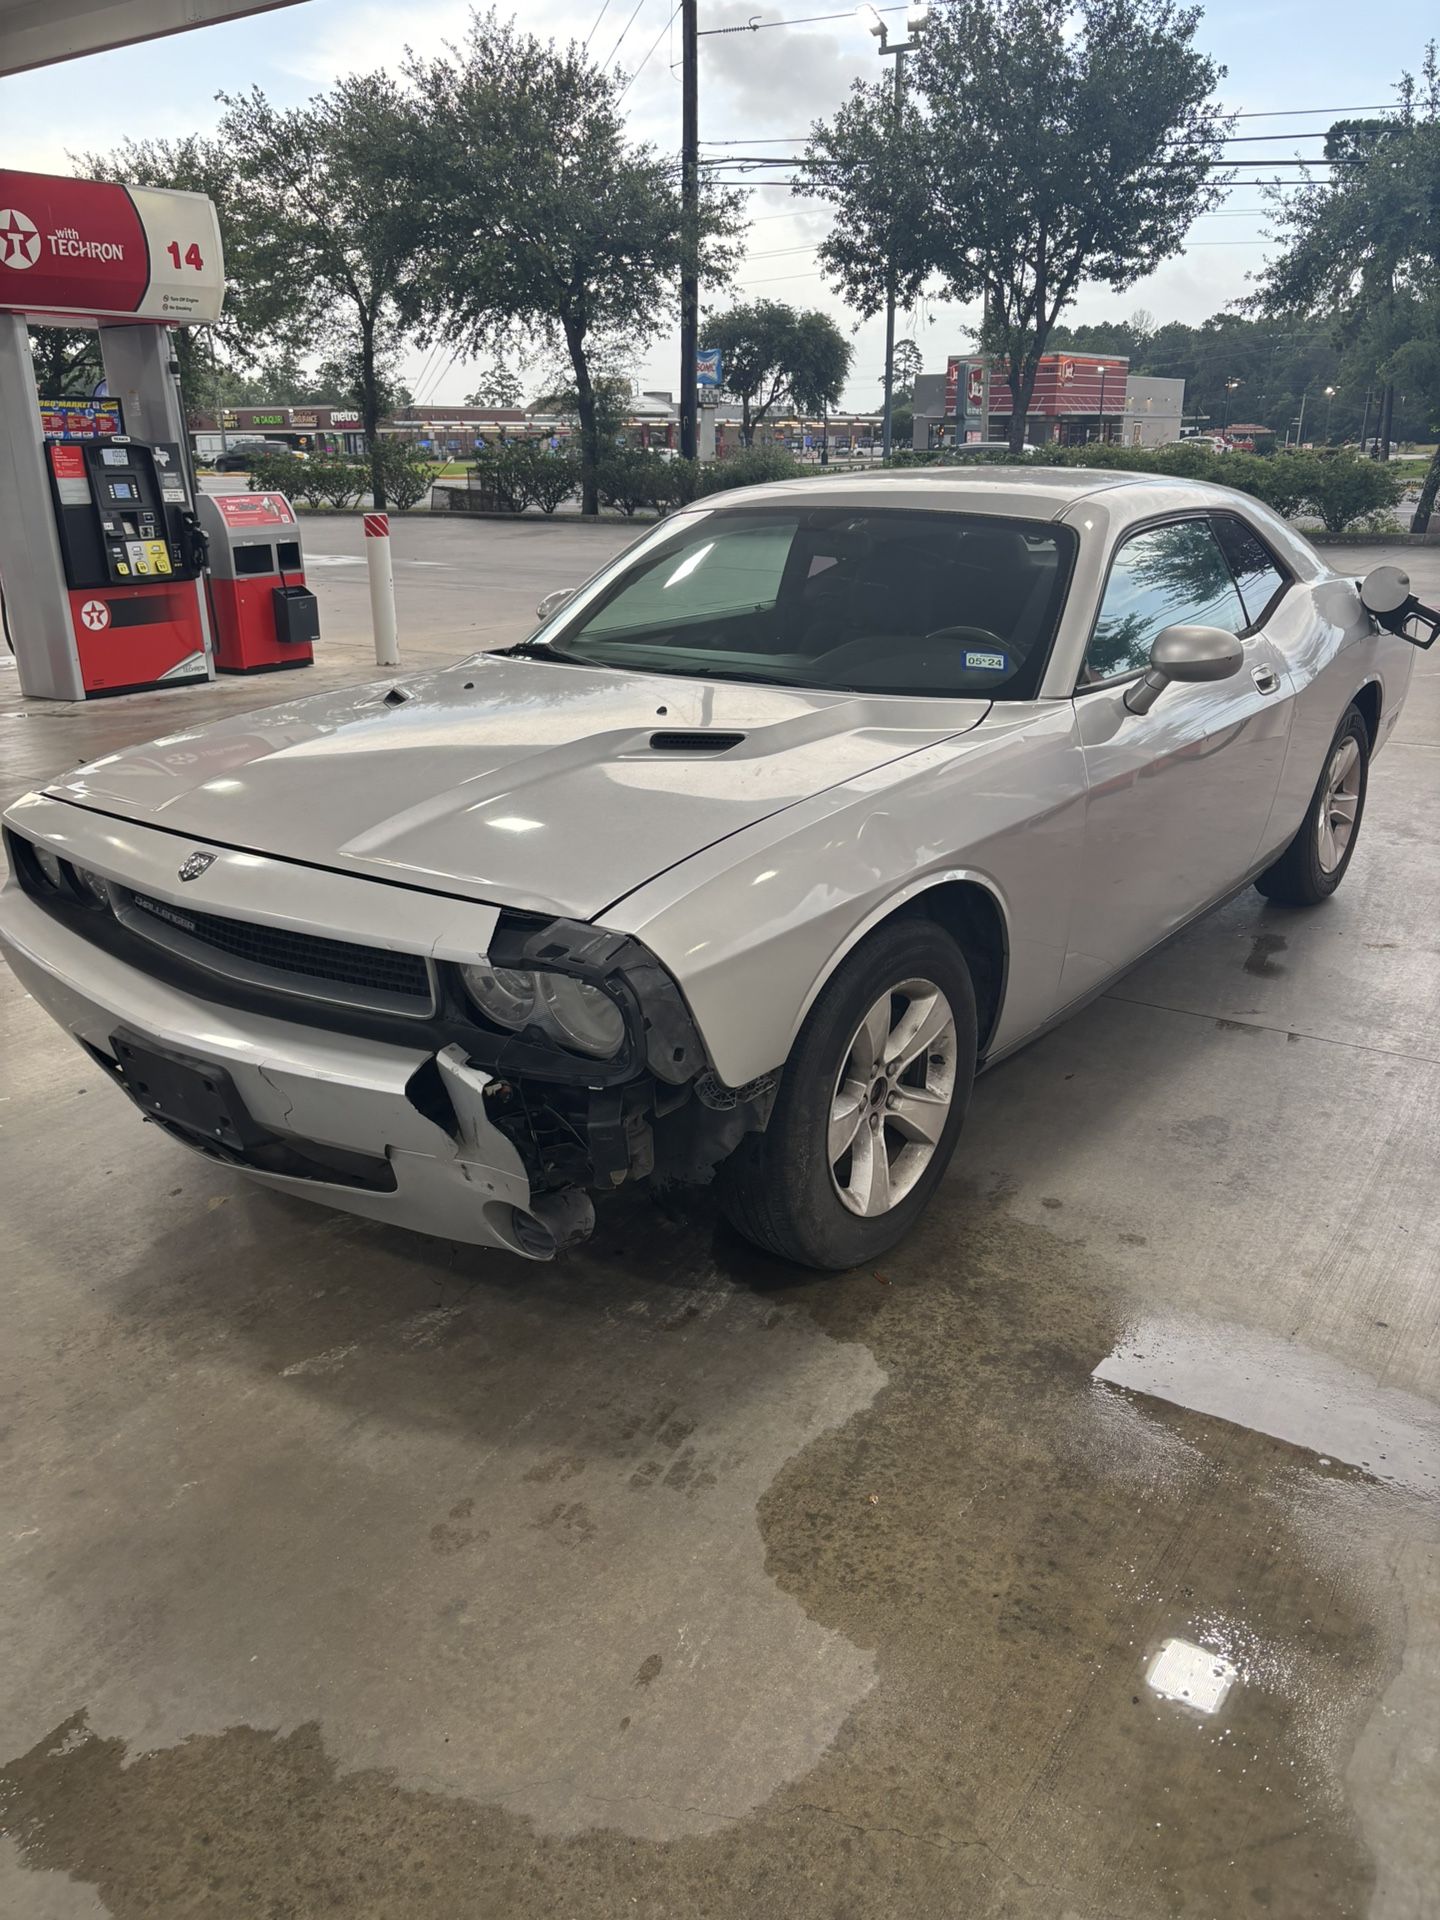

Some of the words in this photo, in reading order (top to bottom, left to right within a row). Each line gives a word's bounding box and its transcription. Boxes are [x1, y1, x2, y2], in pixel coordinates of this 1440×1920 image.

[56, 228, 79, 239] with
[47, 235, 124, 263] TECHRON
[167, 241, 204, 271] 14
[330, 410, 359, 425] metro
[968, 657, 982, 665] 05
[988, 658, 1002, 667] 24
[134, 895, 196, 932] CHALLENGER
